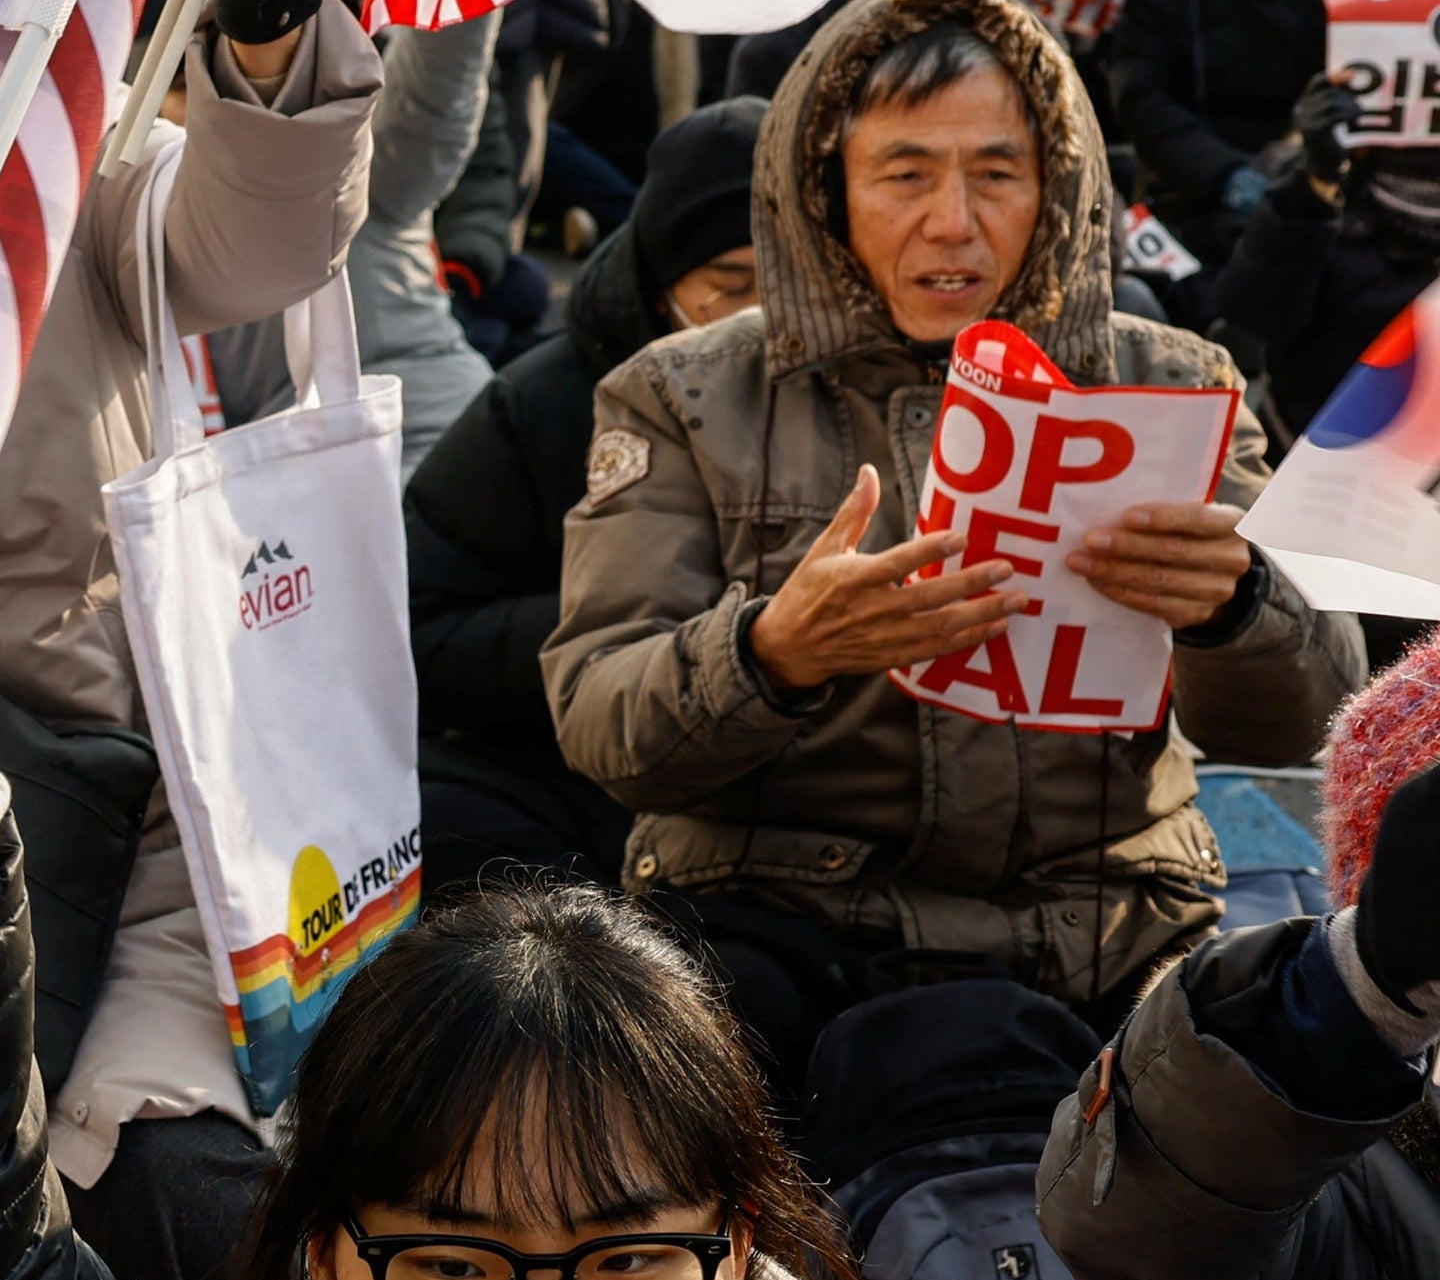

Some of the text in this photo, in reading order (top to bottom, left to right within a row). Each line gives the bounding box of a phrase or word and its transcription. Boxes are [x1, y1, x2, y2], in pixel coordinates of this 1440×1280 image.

[953, 355, 1004, 394] YOON
[239, 565, 313, 631] evian
[301, 893, 345, 950] TOUR
